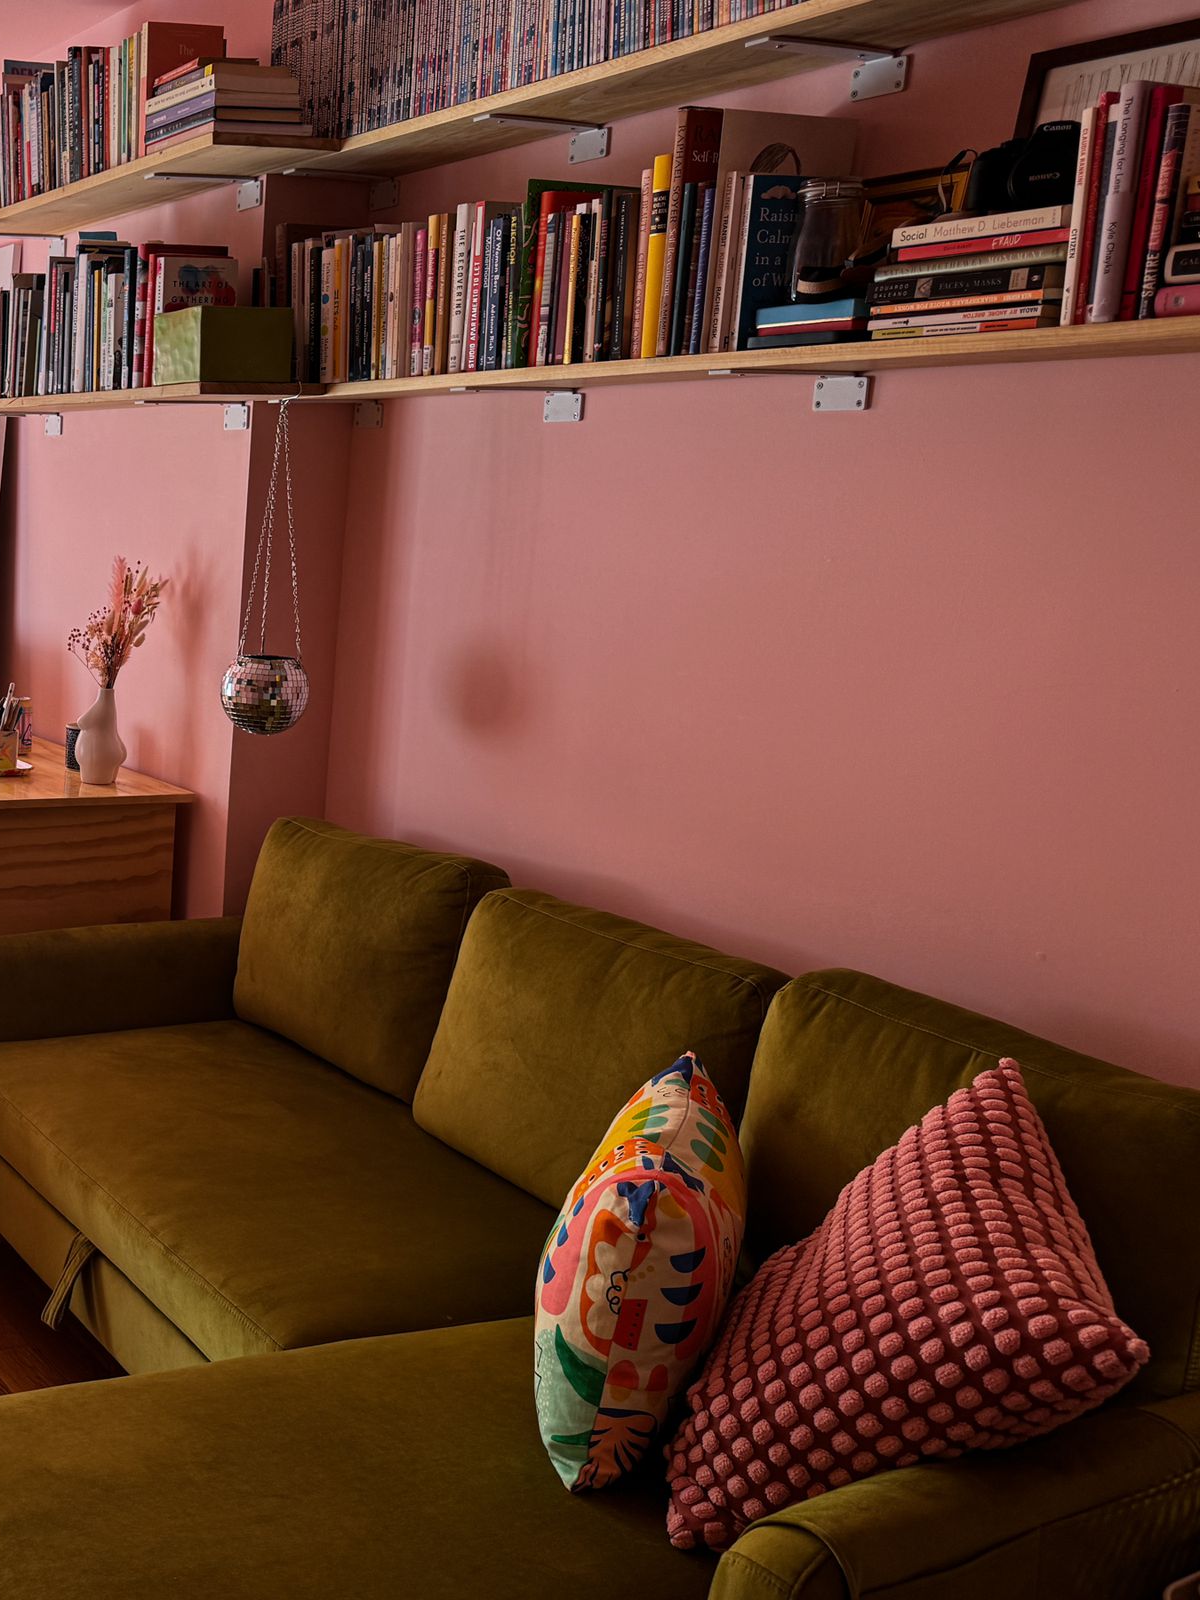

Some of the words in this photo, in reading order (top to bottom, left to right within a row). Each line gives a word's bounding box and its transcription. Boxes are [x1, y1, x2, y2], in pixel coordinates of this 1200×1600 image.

[1123, 95, 1134, 115] The
[1043, 123, 1073, 133] Canon
[1079, 127, 1089, 156] CLAUDIA
[1116, 117, 1130, 157] Longing
[674, 124, 687, 180] RAPHAEL
[1115, 158, 1125, 170] for
[1028, 171, 1060, 182] Canon
[1075, 157, 1085, 187] RANKINE
[1157, 157, 1172, 199] Essays
[641, 175, 651, 198] EASY
[724, 176, 732, 212] OUTLINE
[639, 199, 649, 233] BEAUTY
[669, 184, 680, 224] SOYER
[703, 197, 711, 219] JOAN
[759, 207, 801, 222] Raisin
[495, 228, 502, 239] Of
[699, 222, 708, 253] DIDION
[719, 214, 729, 249] TRANSIT
[898, 227, 927, 242] Social
[932, 221, 976, 238] Matthew
[977, 219, 987, 231] D
[991, 209, 1046, 230] Lieberman
[1106, 220, 1118, 240] Kyle
[1150, 202, 1165, 246] Literary
[508, 215, 517, 265] REJECTION
[989, 233, 1022, 249] FRAUD
[1068, 228, 1078, 260] CITIZEN
[482, 236, 491, 288] Motherhood
[493, 241, 501, 273] Woman
[716, 252, 725, 280] KUDOS
[754, 252, 769, 265] in
[774, 256, 781, 265] a
[1101, 241, 1115, 275] Chayka
[173, 280, 189, 288] THE
[195, 280, 212, 288] ART
[452, 251, 466, 316] RECOVERING
[694, 272, 703, 300] SOUTH
[752, 272, 770, 287] of
[873, 282, 909, 293] EDUARDO
[937, 279, 963, 290] FACES
[973, 276, 1002, 287] MASKS
[1142, 250, 1161, 298] SARTRE
[171, 295, 230, 304] GATHERING
[713, 286, 721, 317] RACHEL
[872, 289, 908, 300] GALEANO
[488, 303, 496, 335] Adrienne
[961, 310, 985, 320] BRETON
[1018, 305, 1039, 314] NADJA
[710, 318, 718, 340] CUSK
[467, 343, 475, 369] STUDIO
